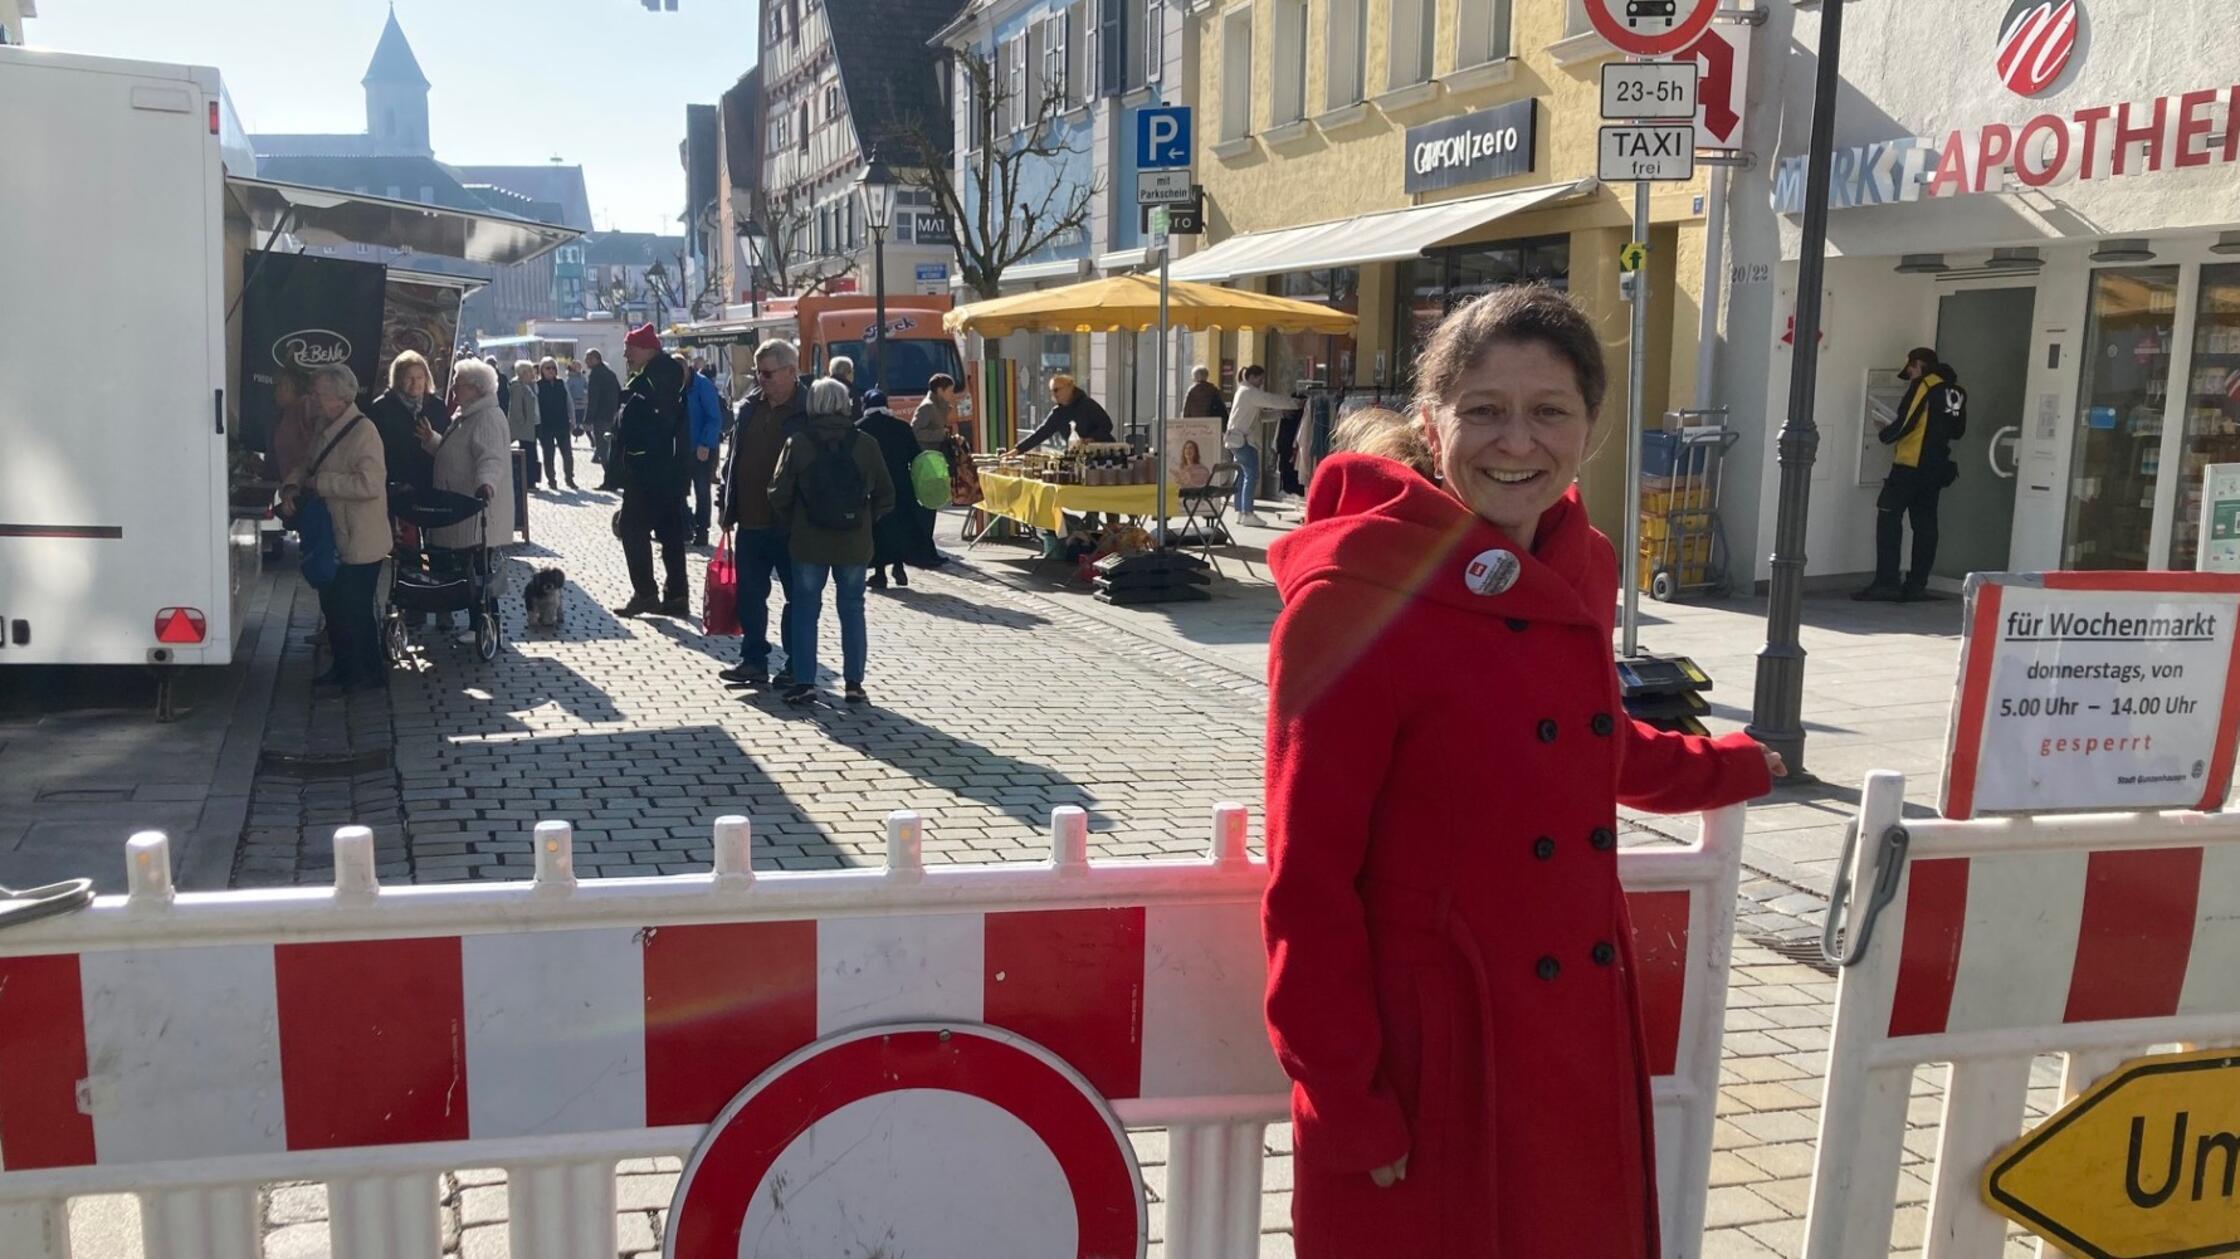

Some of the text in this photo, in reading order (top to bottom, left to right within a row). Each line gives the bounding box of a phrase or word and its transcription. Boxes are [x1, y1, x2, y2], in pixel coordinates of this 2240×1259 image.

[1617, 81, 1683, 102] 23-5h
[1612, 132, 1681, 157] TAXI
[1632, 161, 1661, 174] frei
[1157, 177, 1170, 185] mit
[1140, 189, 1187, 199] Parkschein
[1732, 263, 1768, 283] 20/22
[2007, 612, 2216, 636] für Wochenmarkt
[2027, 661, 2183, 682] donnerstags, von
[2000, 699, 2041, 717] 5.00
[2045, 697, 2079, 716] Uhr
[2110, 697, 2160, 716] 14.00
[2166, 696, 2197, 715] Uhr
